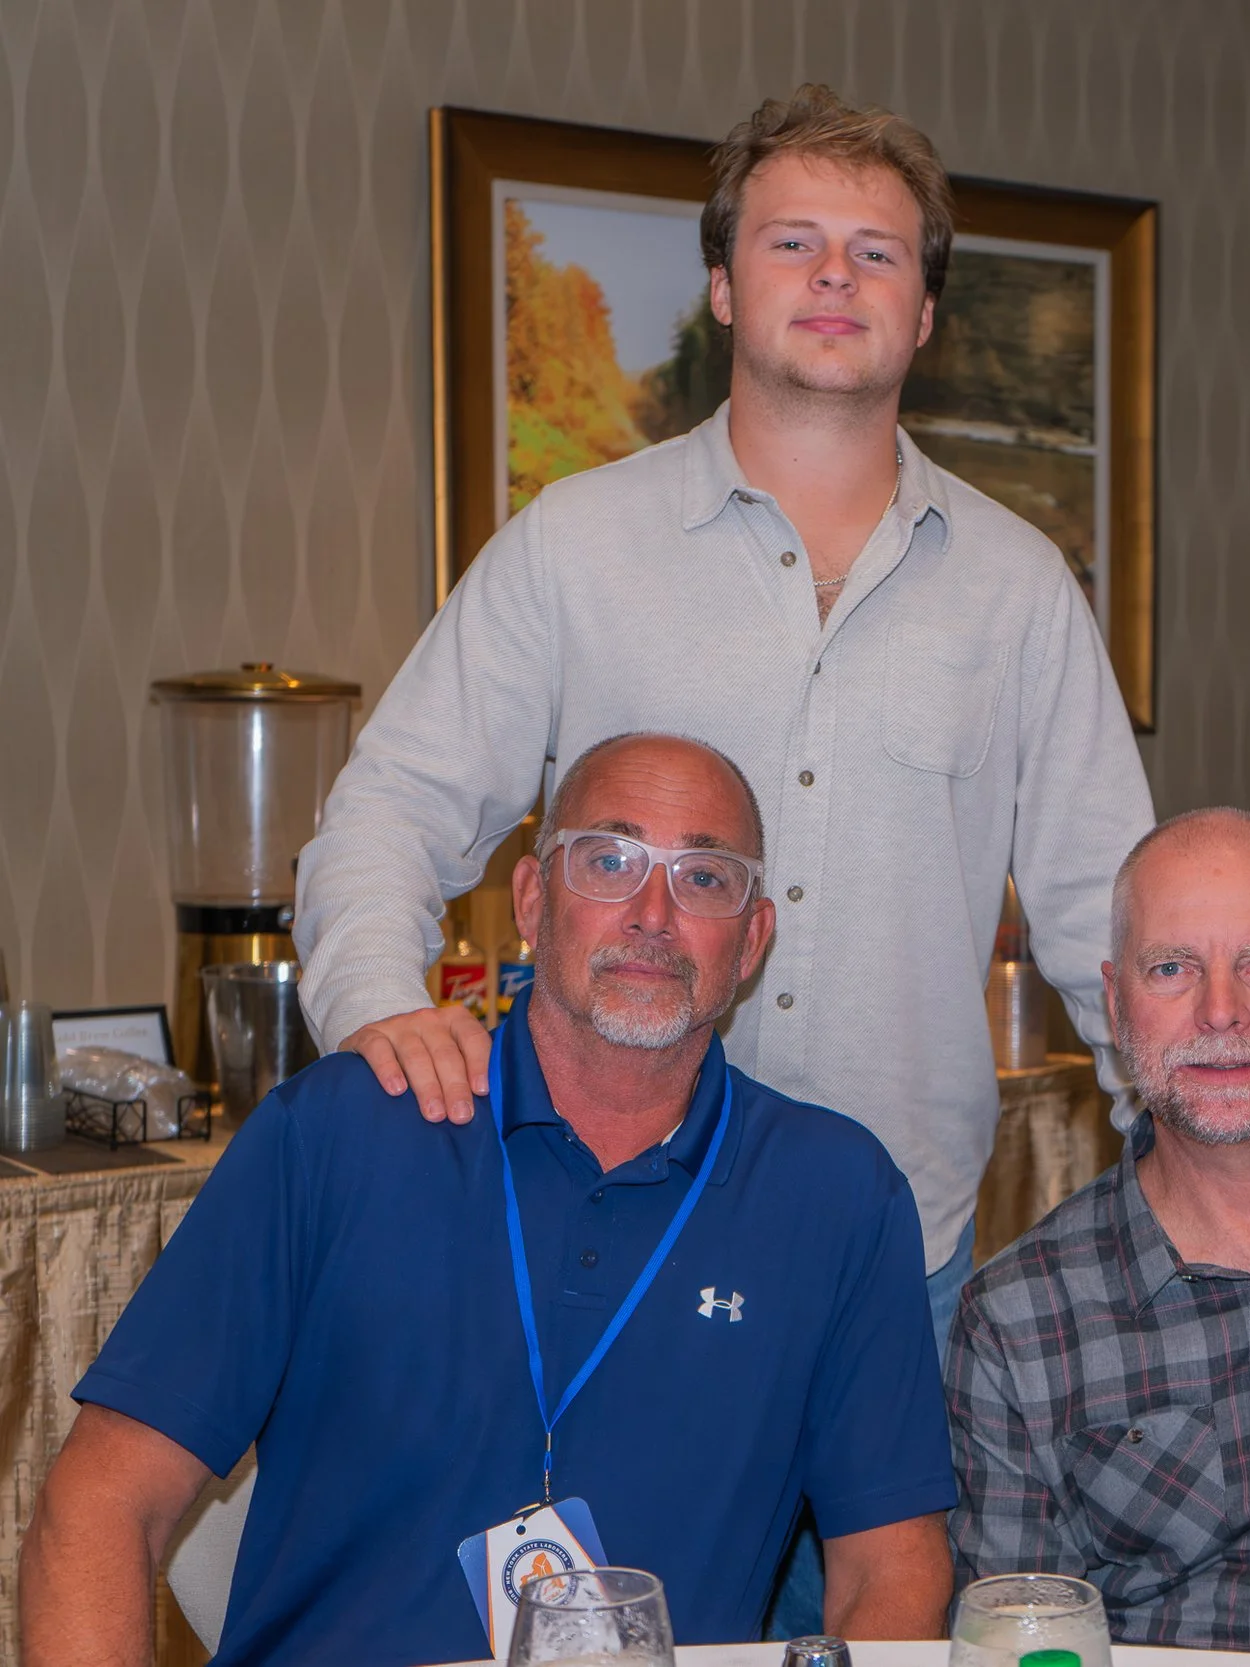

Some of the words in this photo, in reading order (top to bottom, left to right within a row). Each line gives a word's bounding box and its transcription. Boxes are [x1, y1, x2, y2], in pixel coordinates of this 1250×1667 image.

[508, 1554, 520, 1568] YORK
[519, 1543, 538, 1554] STATE
[540, 1543, 569, 1562] LABORERS
